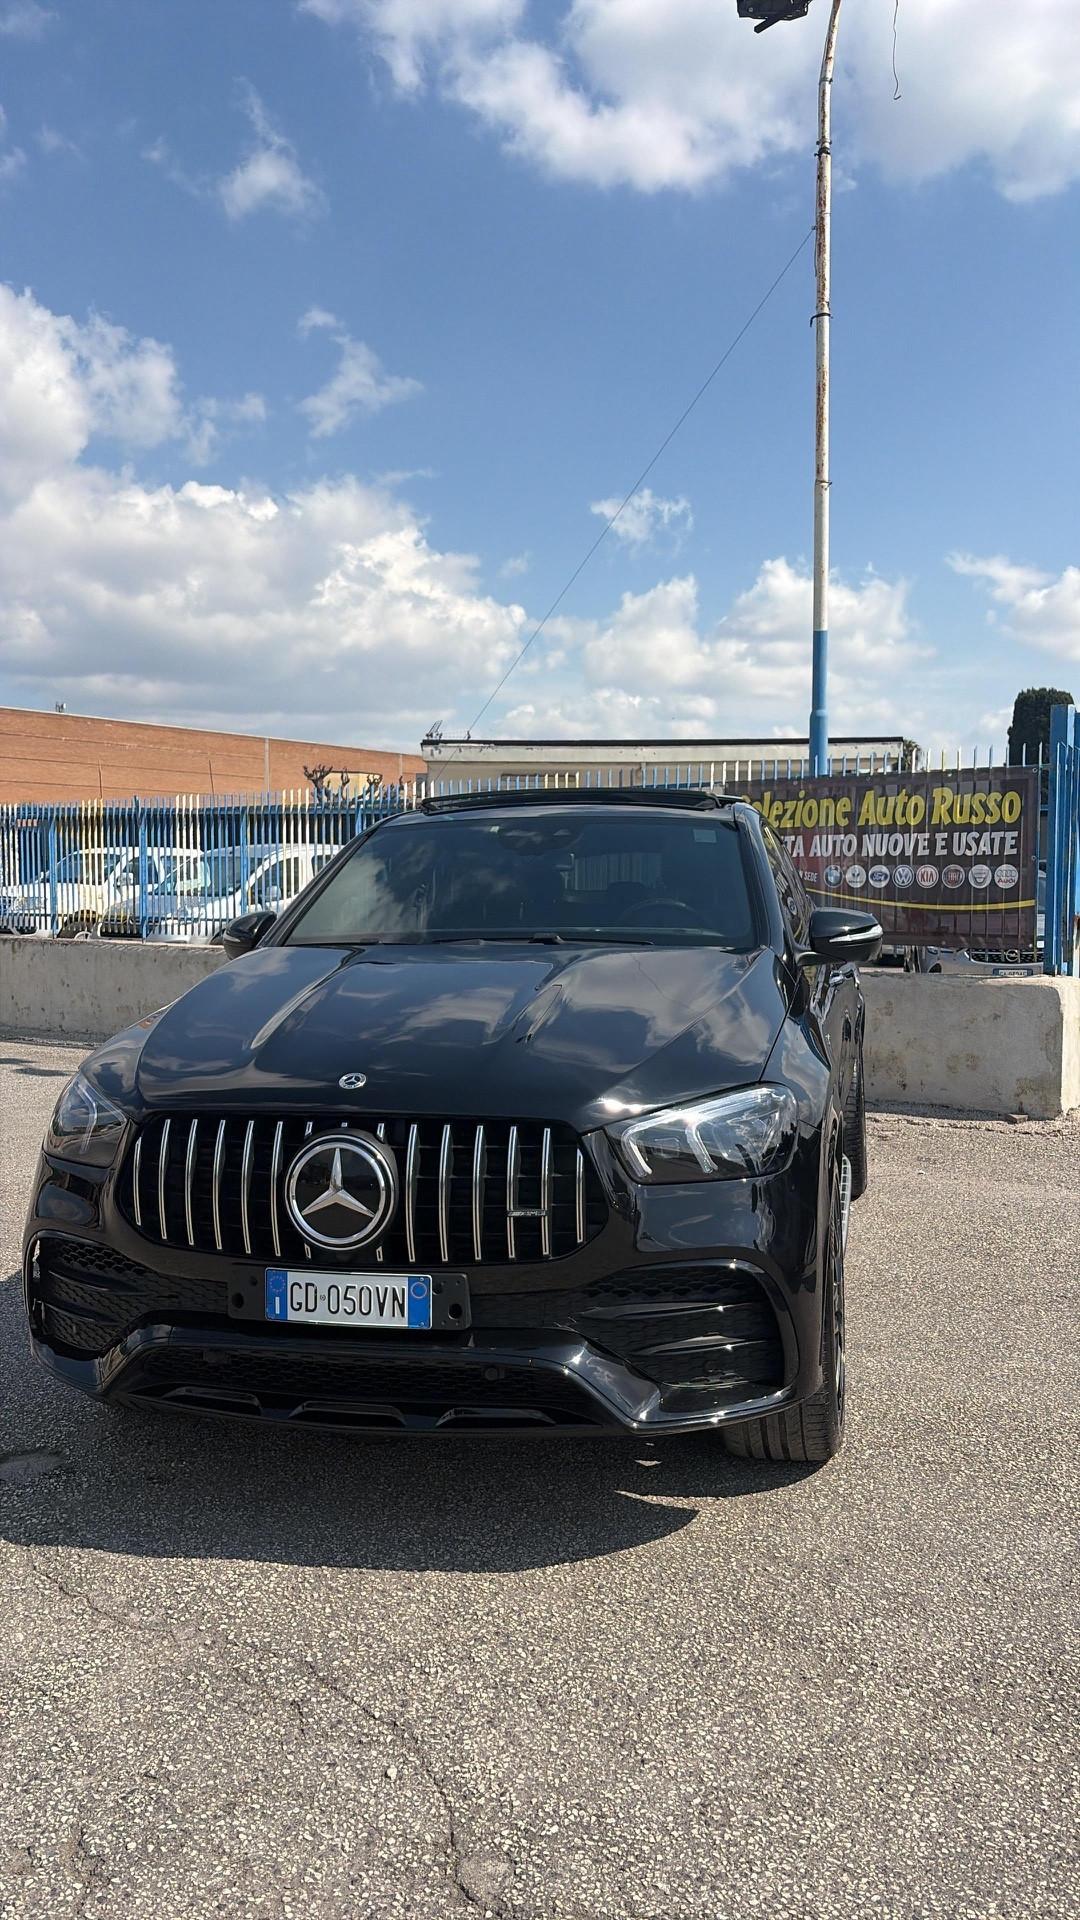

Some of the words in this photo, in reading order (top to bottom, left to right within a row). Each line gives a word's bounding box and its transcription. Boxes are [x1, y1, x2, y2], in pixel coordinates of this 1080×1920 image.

[857, 789, 925, 826] Auto
[931, 787, 1022, 825] Russo
[809, 833, 857, 858] AUTO
[861, 832, 930, 857] NUOVE
[935, 832, 948, 856] E
[953, 831, 1019, 856] USATE
[921, 871, 934, 883] KIA
[290, 1281, 318, 1313] GD
[327, 1284, 406, 1318] 050VN
